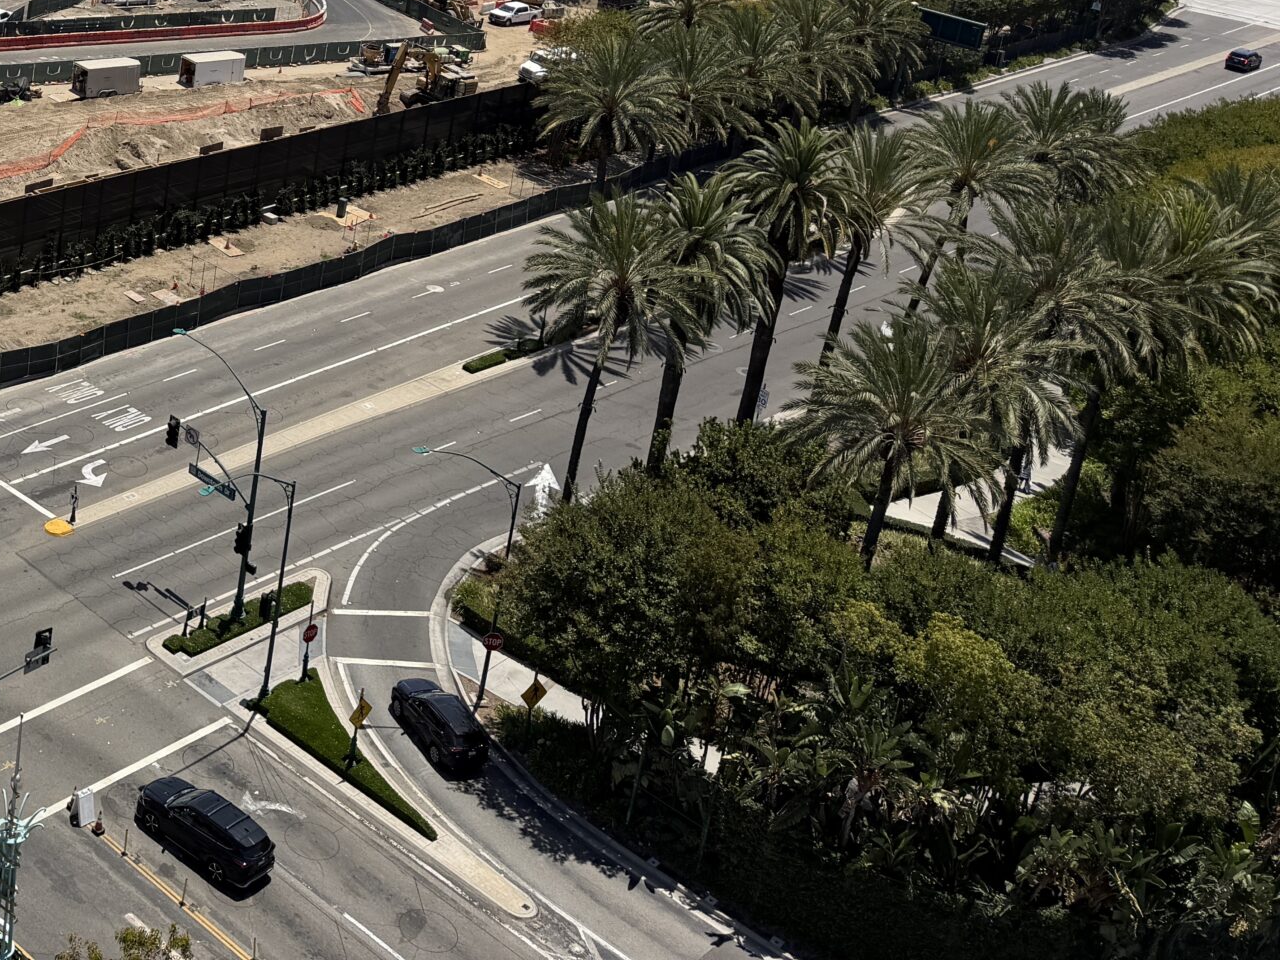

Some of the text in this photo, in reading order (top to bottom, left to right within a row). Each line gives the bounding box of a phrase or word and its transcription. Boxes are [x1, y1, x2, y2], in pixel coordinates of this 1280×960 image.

[44, 378, 105, 404] ONLY
[90, 404, 153, 432] ONLY
[304, 628, 319, 640] STOP
[483, 637, 502, 647] STOP
